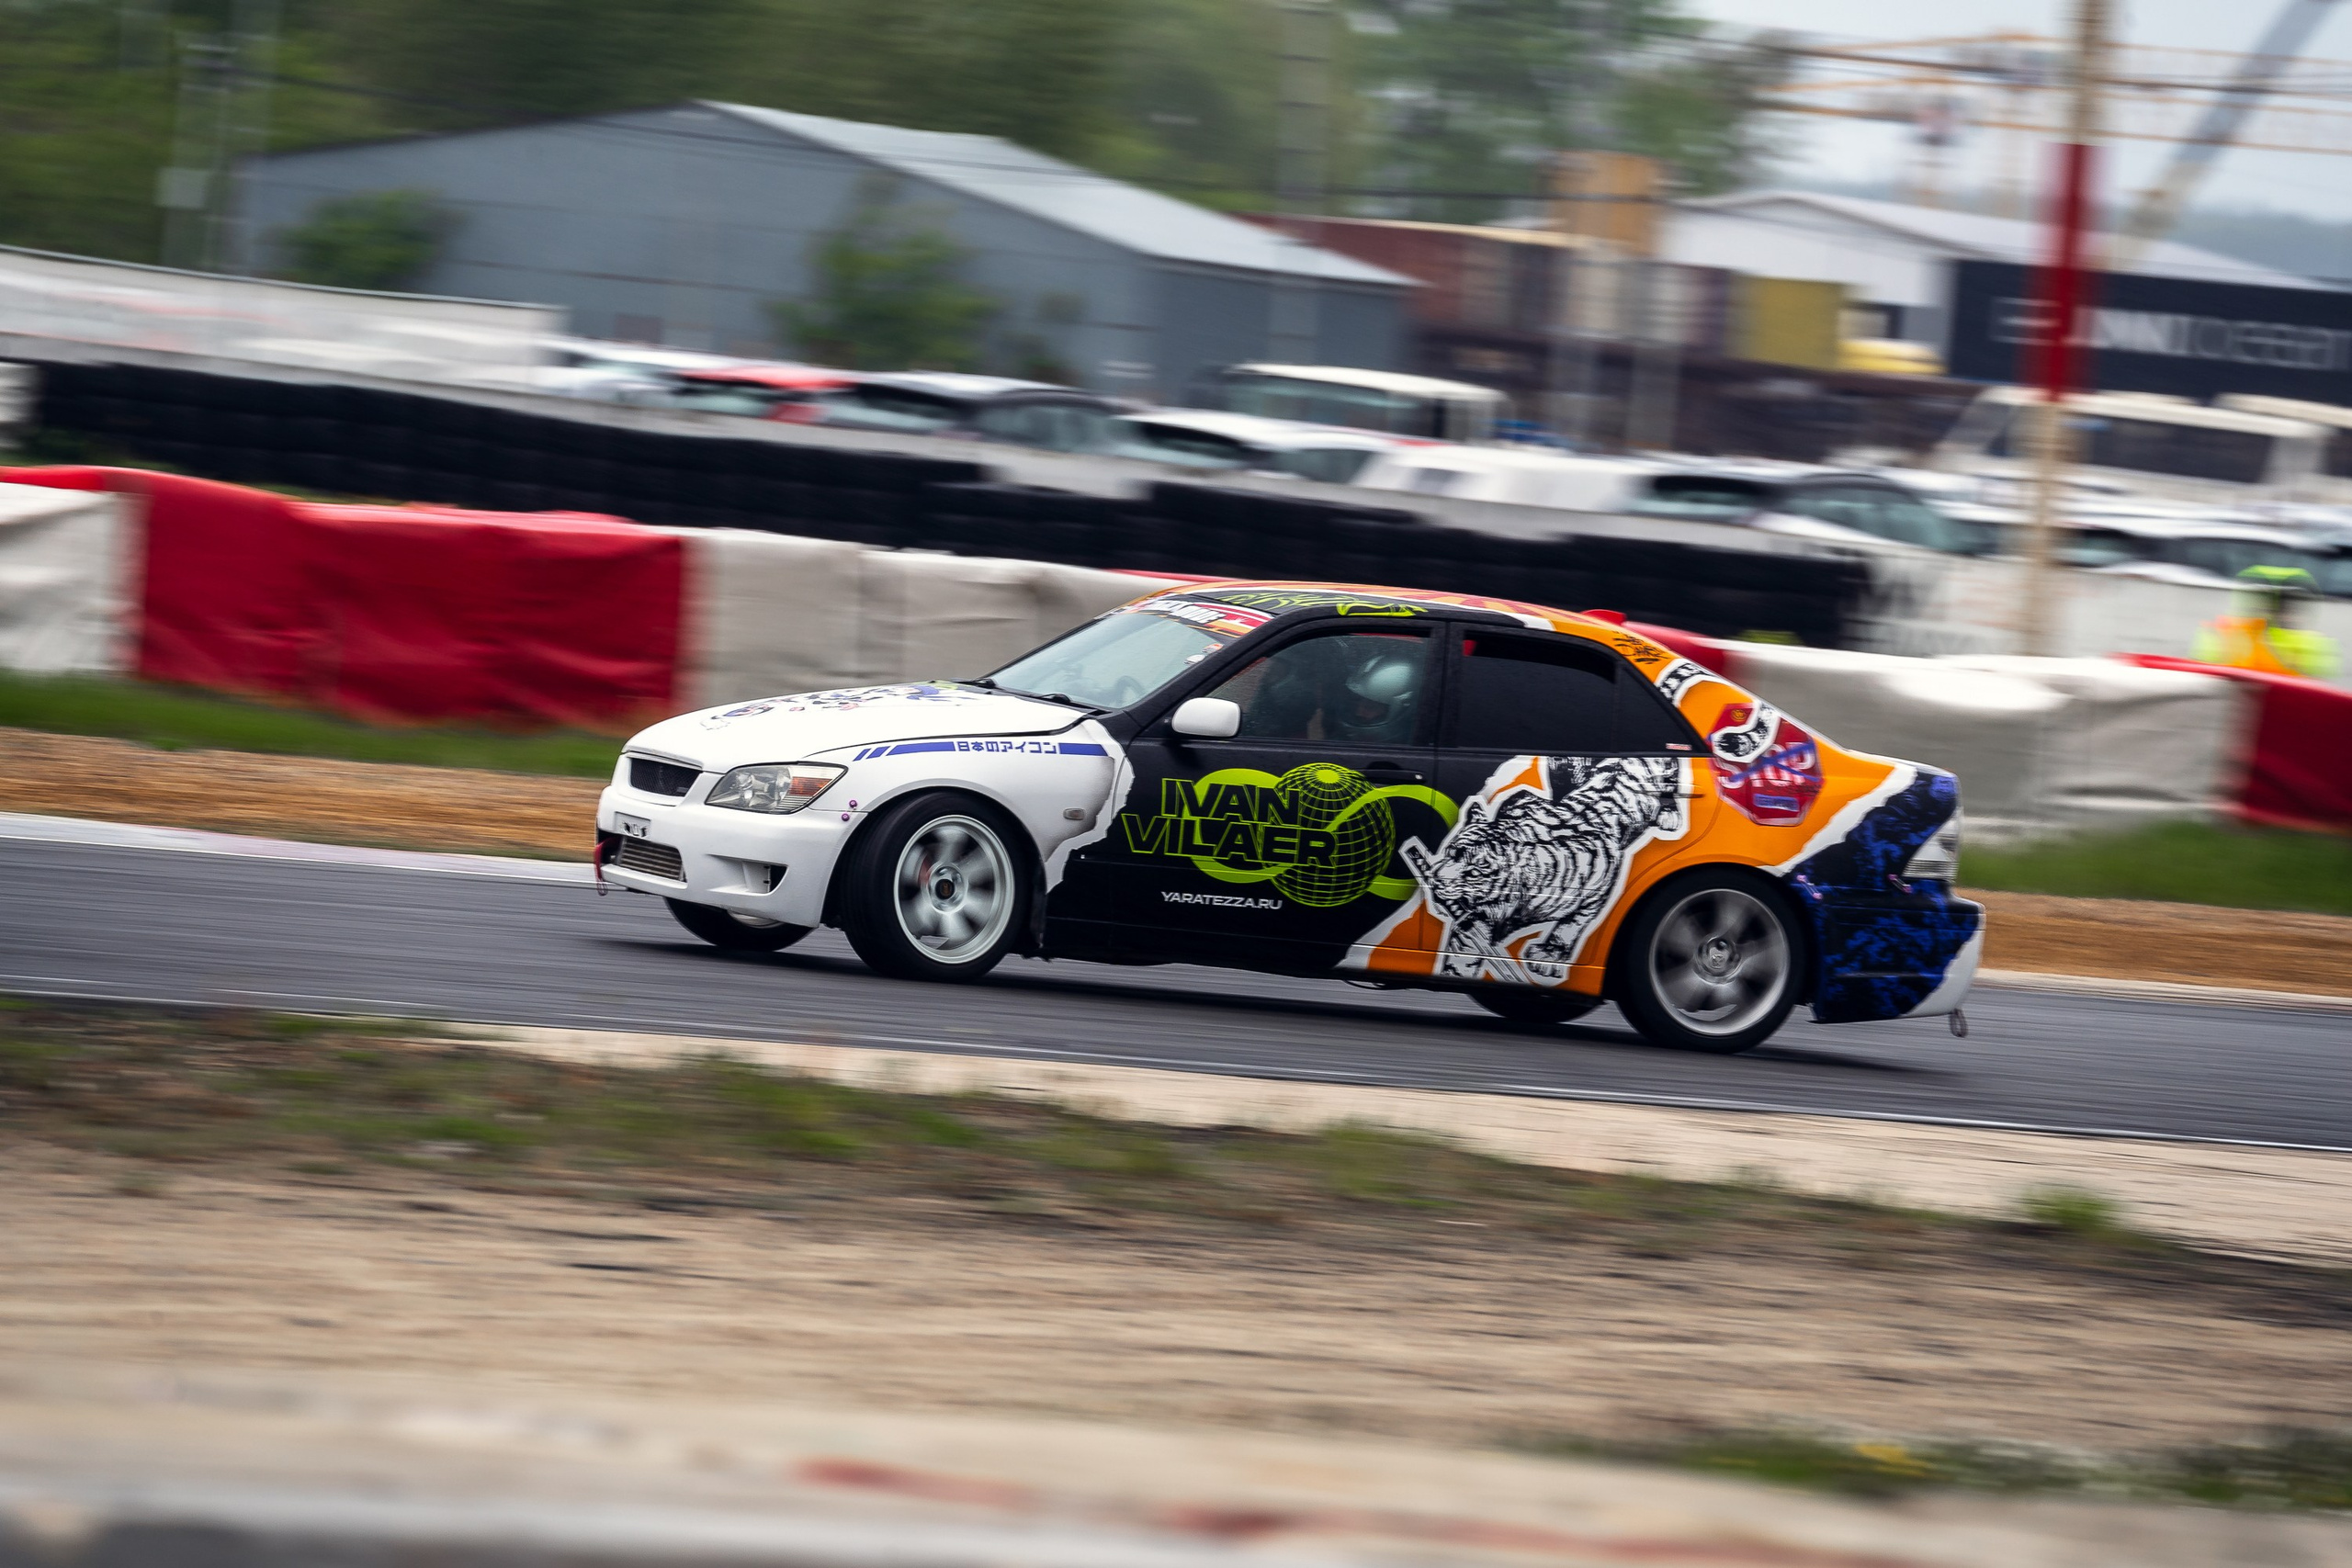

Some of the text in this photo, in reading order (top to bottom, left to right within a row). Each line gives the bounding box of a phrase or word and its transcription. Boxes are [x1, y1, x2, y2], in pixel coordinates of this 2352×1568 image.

[1160, 777, 1302, 828] IVAN
[1120, 813, 1339, 868] VILAER
[1160, 891, 1283, 910] YARATEZZA.RU
